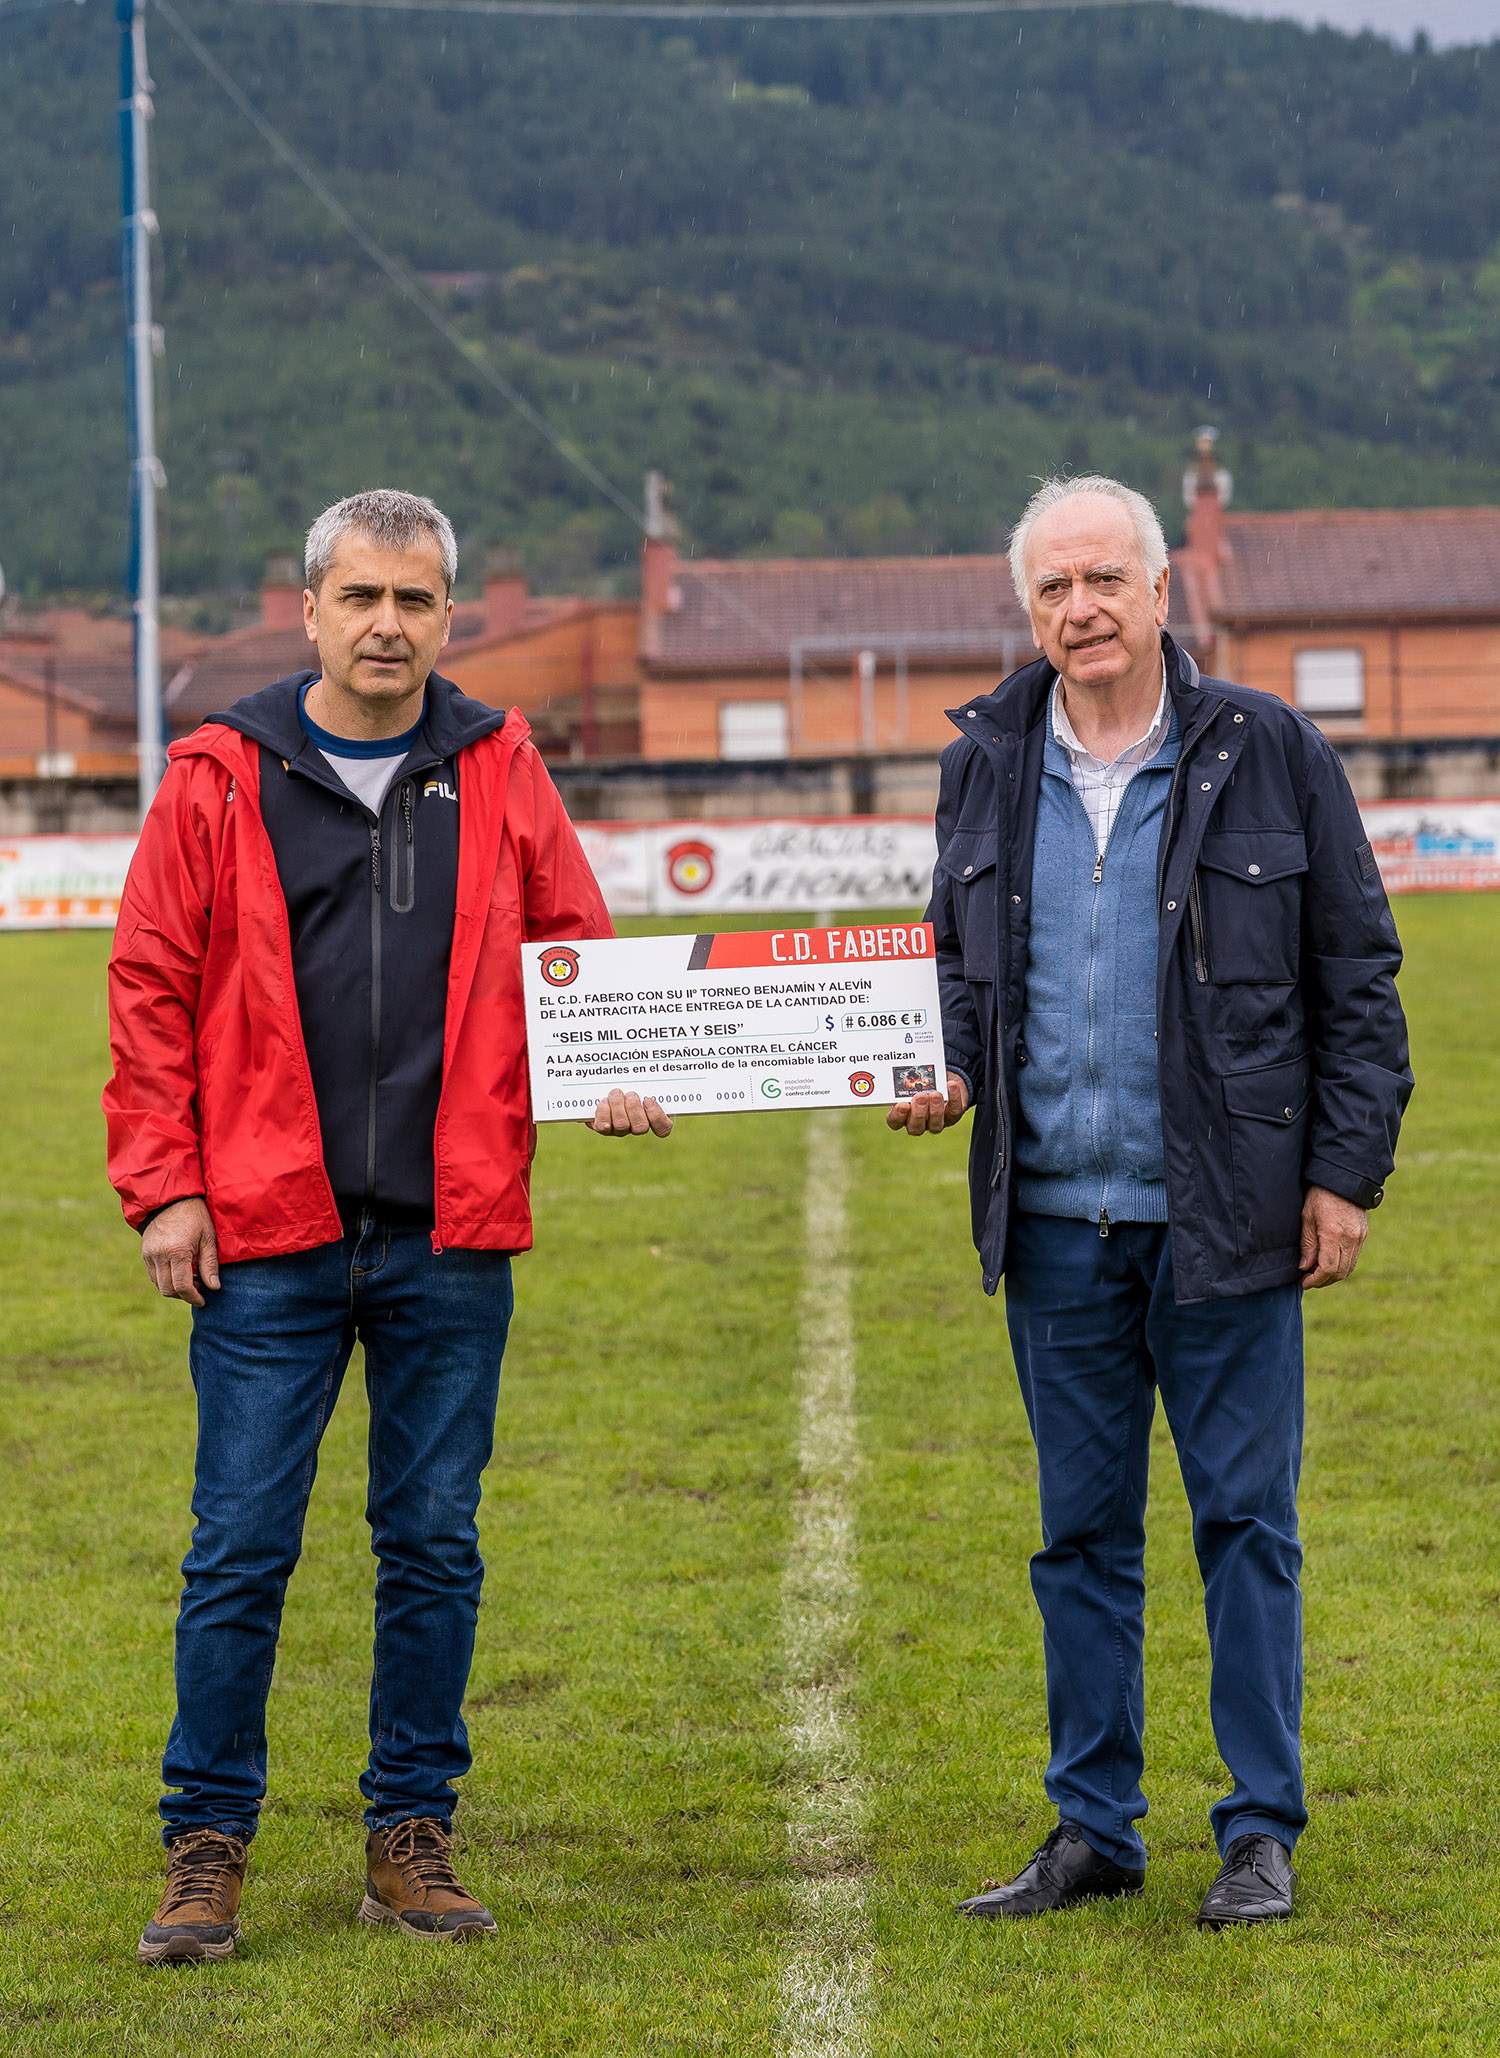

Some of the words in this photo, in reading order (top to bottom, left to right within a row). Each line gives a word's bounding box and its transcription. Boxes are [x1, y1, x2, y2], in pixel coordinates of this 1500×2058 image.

[424, 781, 458, 802] FIL
[771, 932, 817, 962] C.D.
[827, 927, 928, 959] FABERO
[539, 996, 554, 1006] EL
[558, 995, 581, 1005] C.D.
[585, 992, 634, 1003] FABERO
[637, 990, 663, 1001] CON
[667, 989, 683, 1000] SU
[700, 986, 751, 998] TORNEO
[754, 980, 815, 995] BENJAMÍN
[818, 982, 828, 992] Y
[829, 978, 872, 991] ALEVÍN
[541, 1009, 557, 1019] DE
[560, 1009, 575, 1019] LA
[578, 1005, 646, 1018] ANTRACITA
[649, 1004, 682, 1014] HACE
[686, 999, 744, 1012] ENTREGA
[747, 1000, 763, 1009] DE
[766, 999, 782, 1008] LA
[784, 995, 846, 1007] CANTIDAD
[850, 994, 870, 1004] DE:
[825, 1014, 835, 1032] $
[846, 1016, 854, 1028] #
[858, 1014, 897, 1028] 6.086
[900, 1013, 910, 1025] €
[914, 1012, 922, 1025] #
[597, 1028, 623, 1042] MIL
[626, 1026, 687, 1040] OCHETA
[689, 1025, 700, 1036] Y
[546, 1055, 555, 1065] A
[557, 1054, 573, 1064] LA
[575, 1049, 649, 1063] ASOCIACIÓN
[652, 1046, 715, 1059] ESPAÑOLA
[718, 1043, 768, 1056] CONTRA
[771, 1043, 785, 1053] EL
[788, 1039, 838, 1052] CÁNCER
[547, 1067, 572, 1078] Para
[575, 1064, 629, 1078] ayudarles
[632, 1065, 646, 1074] en
[649, 1063, 660, 1072] el
[662, 1060, 718, 1072] desarrollo
[721, 1059, 735, 1069] de
[738, 1059, 748, 1068] la
[751, 1055, 815, 1067] encomiable
[817, 1054, 846, 1065] labor
[849, 1055, 870, 1065] que
[872, 1051, 916, 1062] realizan
